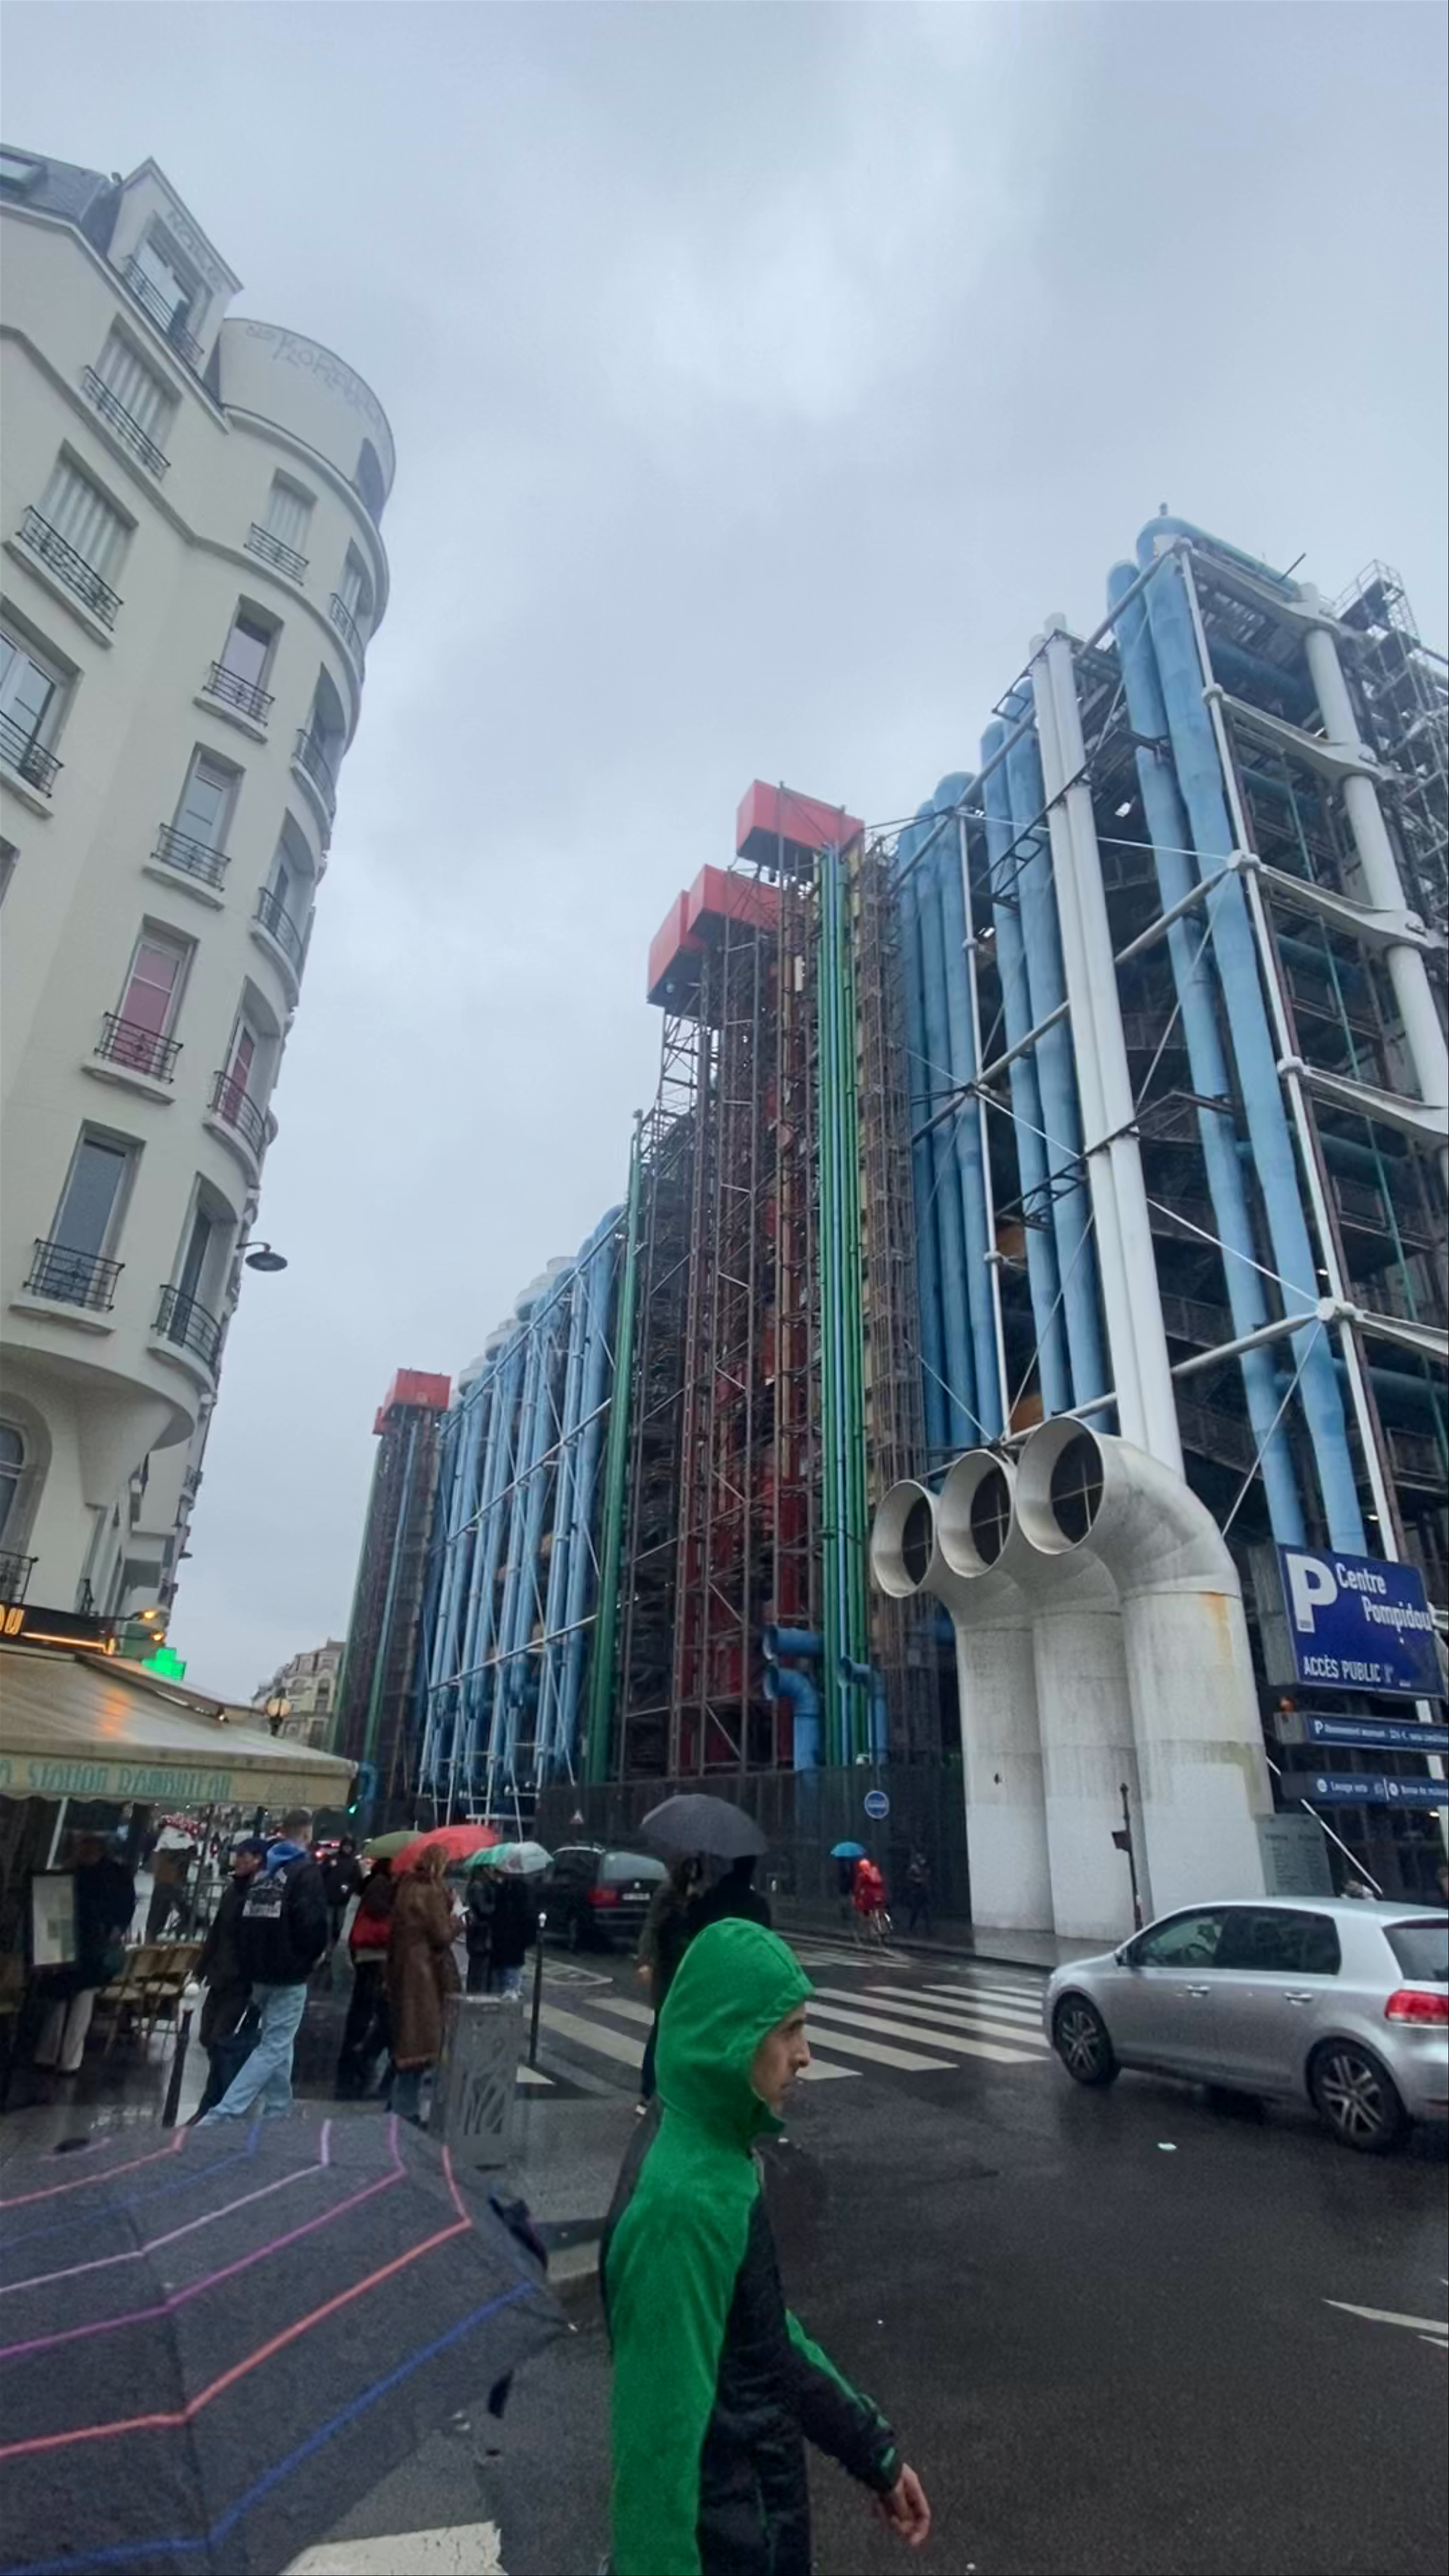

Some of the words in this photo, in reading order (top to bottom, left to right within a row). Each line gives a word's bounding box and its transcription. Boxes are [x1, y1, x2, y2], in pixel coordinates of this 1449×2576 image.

[1285, 1553, 1338, 1633] P
[1335, 1562, 1387, 1595] Centre
[1361, 1595, 1433, 1633] Pompidou
[1303, 1655, 1339, 1679] ACCÈS
[1341, 1661, 1381, 1682] PUBLIC
[28, 1762, 109, 1791] STATION
